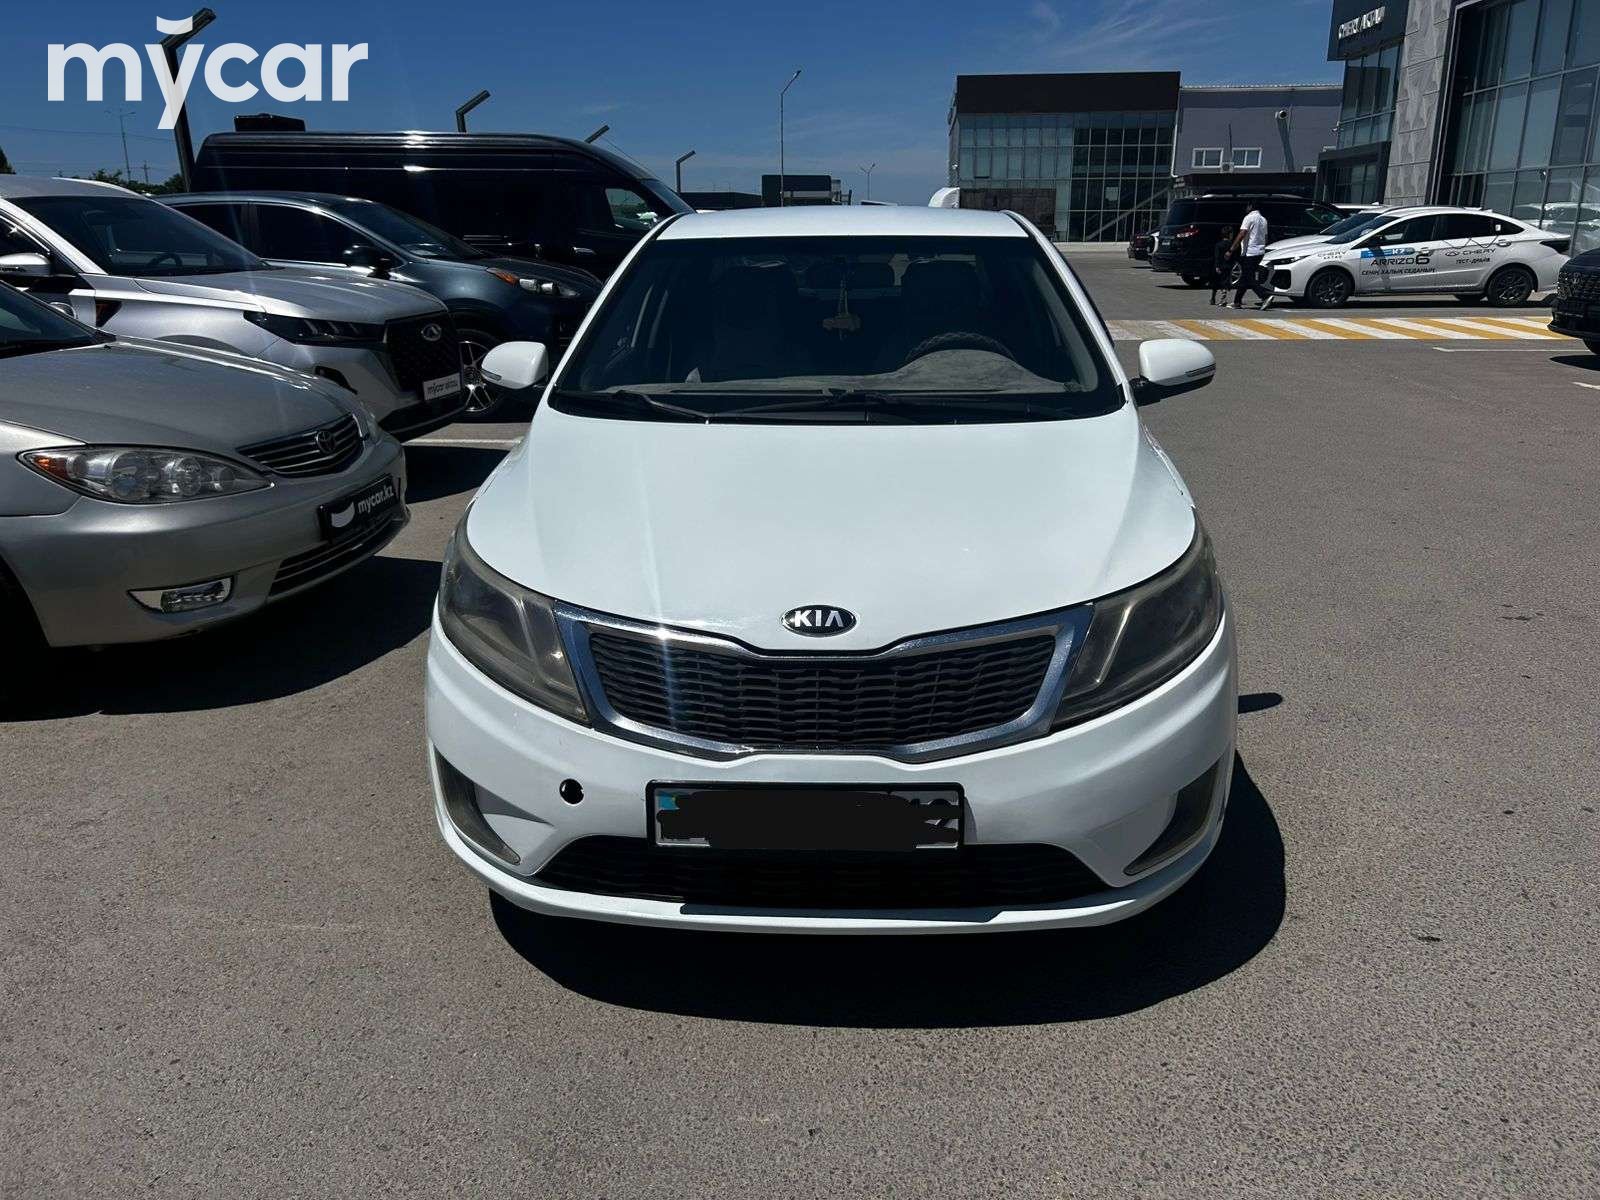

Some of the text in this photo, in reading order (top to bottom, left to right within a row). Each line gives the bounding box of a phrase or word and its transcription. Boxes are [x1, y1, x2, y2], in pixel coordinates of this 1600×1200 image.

[1462, 248, 1496, 256] CHERY
[357, 484, 394, 514] mycar.kz
[794, 609, 844, 628] KIA
